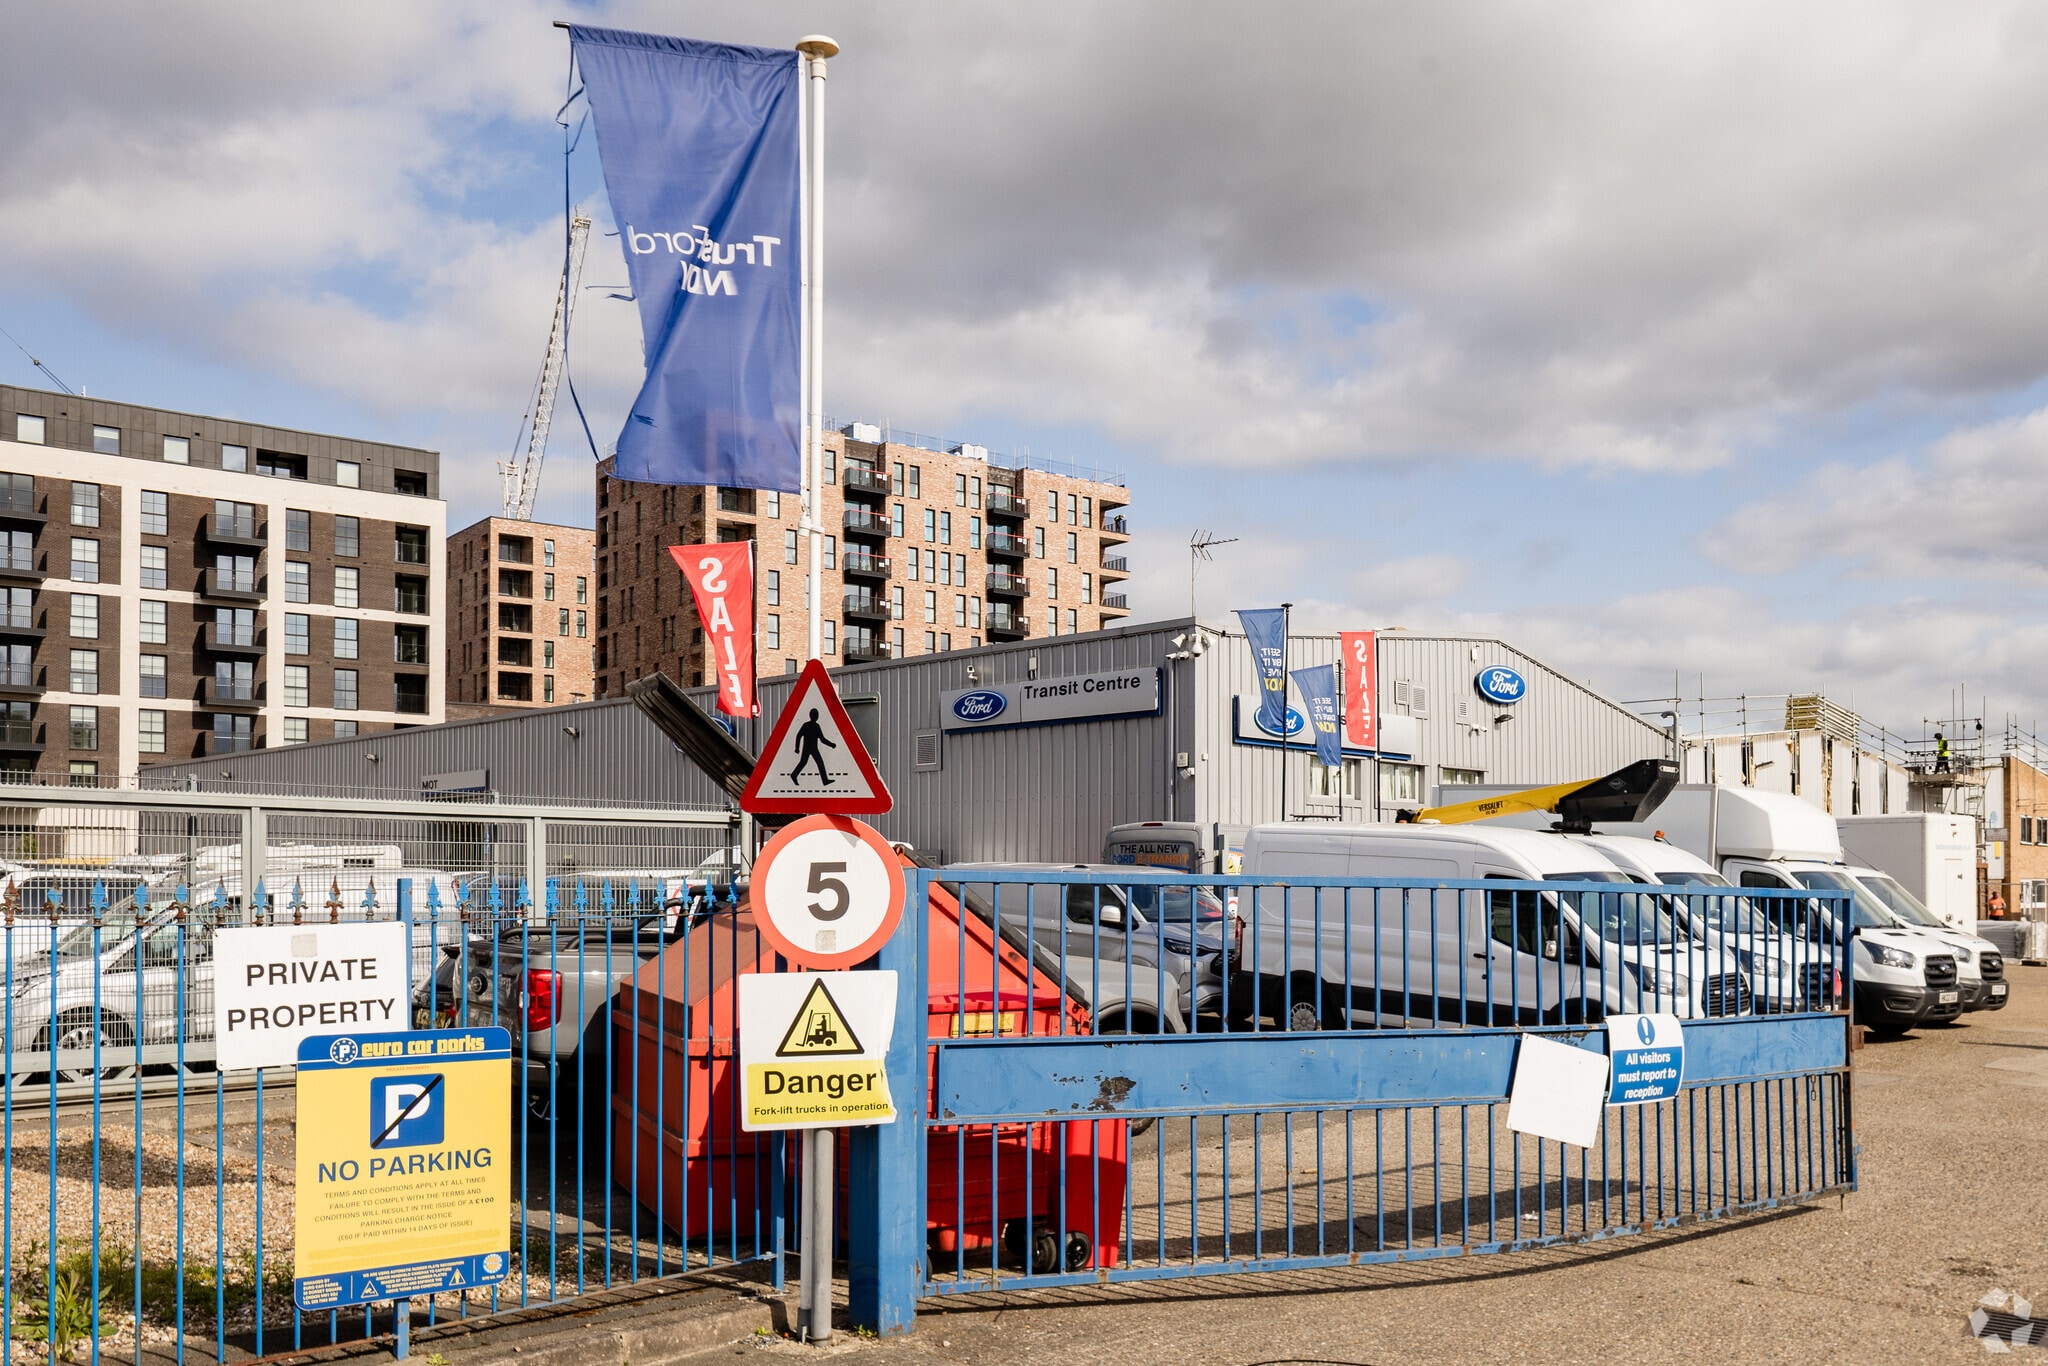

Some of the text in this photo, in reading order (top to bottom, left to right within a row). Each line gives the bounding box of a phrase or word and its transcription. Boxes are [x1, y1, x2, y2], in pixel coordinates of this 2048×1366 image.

[1489, 670, 1519, 696] Ford
[961, 676, 1141, 716] Ford Transit Centre
[422, 780, 438, 790] MOT
[1120, 844, 1180, 854] THE ALL NEW
[1136, 854, 1190, 864] E-TRANSIT
[806, 862, 850, 921] 5
[246, 958, 378, 986] PRIVATE
[228, 998, 396, 1032] PROPERTY
[362, 1041, 404, 1057] euro
[408, 1038, 434, 1054] car
[436, 1034, 485, 1056] parks
[1626, 1052, 1671, 1066] All visitors
[764, 1070, 877, 1100] Danger
[1618, 1067, 1677, 1084] must report to
[1624, 1084, 1664, 1100] reception
[754, 1102, 889, 1116] Fork-lift trucks in operation
[318, 1148, 492, 1183] NO PARKING
[324, 1190, 350, 1199] TERMS
[352, 1188, 368, 1196] AND
[370, 1183, 414, 1195] CONDITIONS
[415, 1181, 438, 1190] APPLY
[450, 1178, 463, 1186] ALL
[465, 1176, 486, 1184] TIMES
[314, 1212, 360, 1223] CONDITIONS
[362, 1209, 380, 1217] WILL
[382, 1206, 409, 1215] RESULT
[435, 1201, 456, 1209] ISSUE
[475, 1196, 494, 1205] £100
[329, 1201, 361, 1210] FAILURE
[374, 1196, 405, 1206] COMPLY
[407, 1194, 425, 1202] WITH
[426, 1192, 440, 1200] THE
[442, 1190, 465, 1199] TERMS
[338, 1233, 353, 1242] (£60
[363, 1230, 380, 1238] PAID
[382, 1226, 407, 1236] WITHIN
[418, 1223, 438, 1231] DAYS
[450, 1219, 473, 1228] ISSUE)
[360, 1212, 452, 1228] PARKING CHARGE NOTICE
